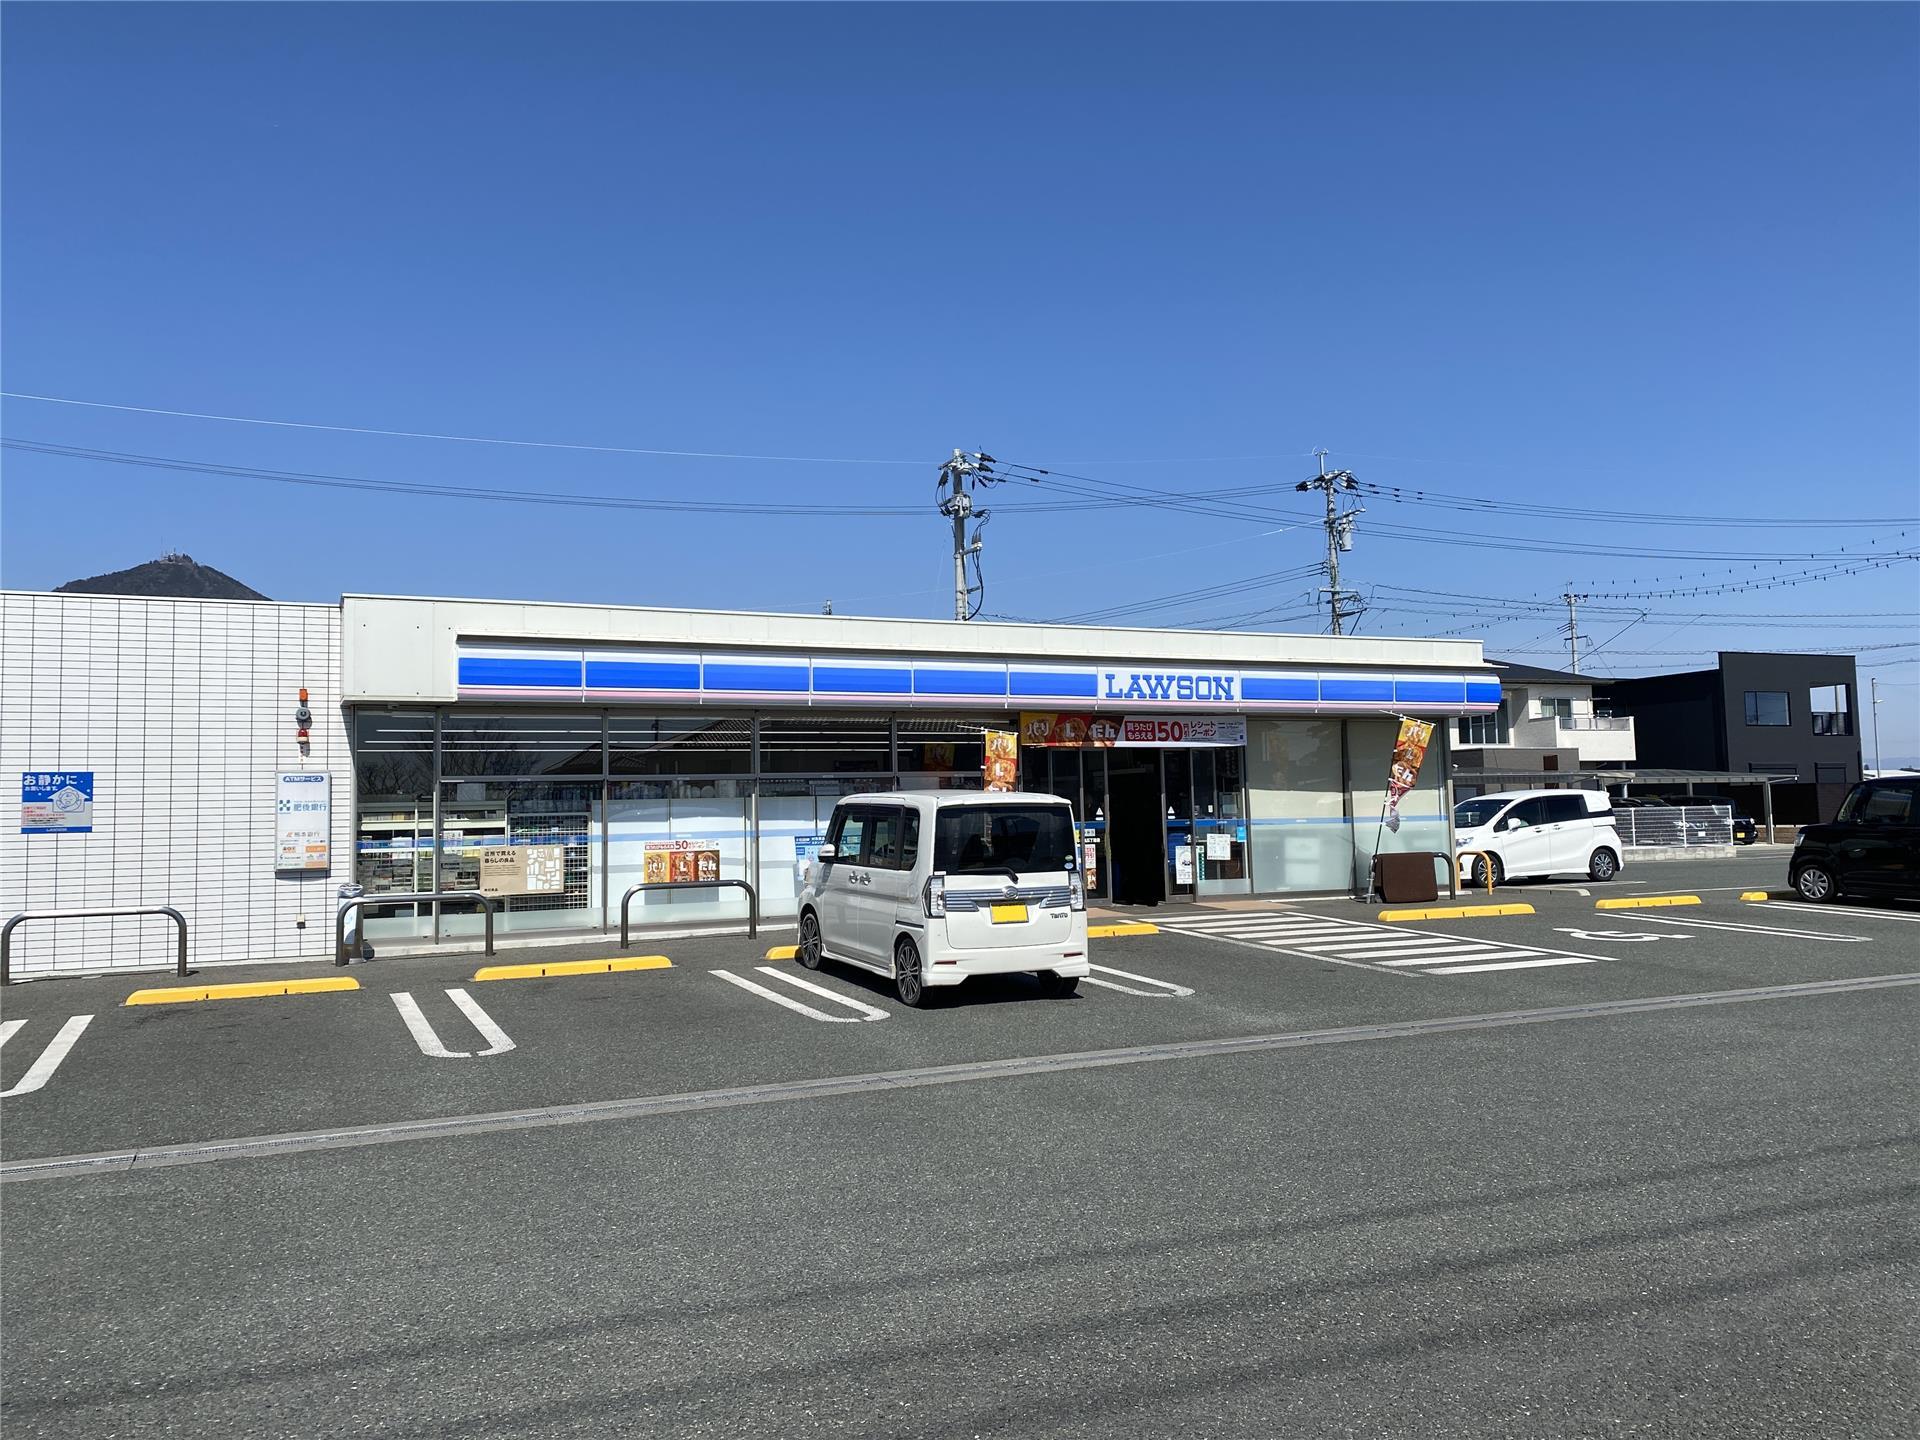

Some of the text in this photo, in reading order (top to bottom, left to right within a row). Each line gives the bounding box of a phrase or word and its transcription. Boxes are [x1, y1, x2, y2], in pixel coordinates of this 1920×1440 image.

[1105, 674, 1234, 700] LAWSON
[1190, 720, 1216, 729] レシート
[1127, 731, 1153, 740] もらえる
[1157, 721, 1184, 742] 50
[1190, 729, 1217, 737] クーポン
[23, 774, 78, 785] お静かに
[293, 803, 327, 811] 肥後銀行
[675, 840, 688, 850] 50
